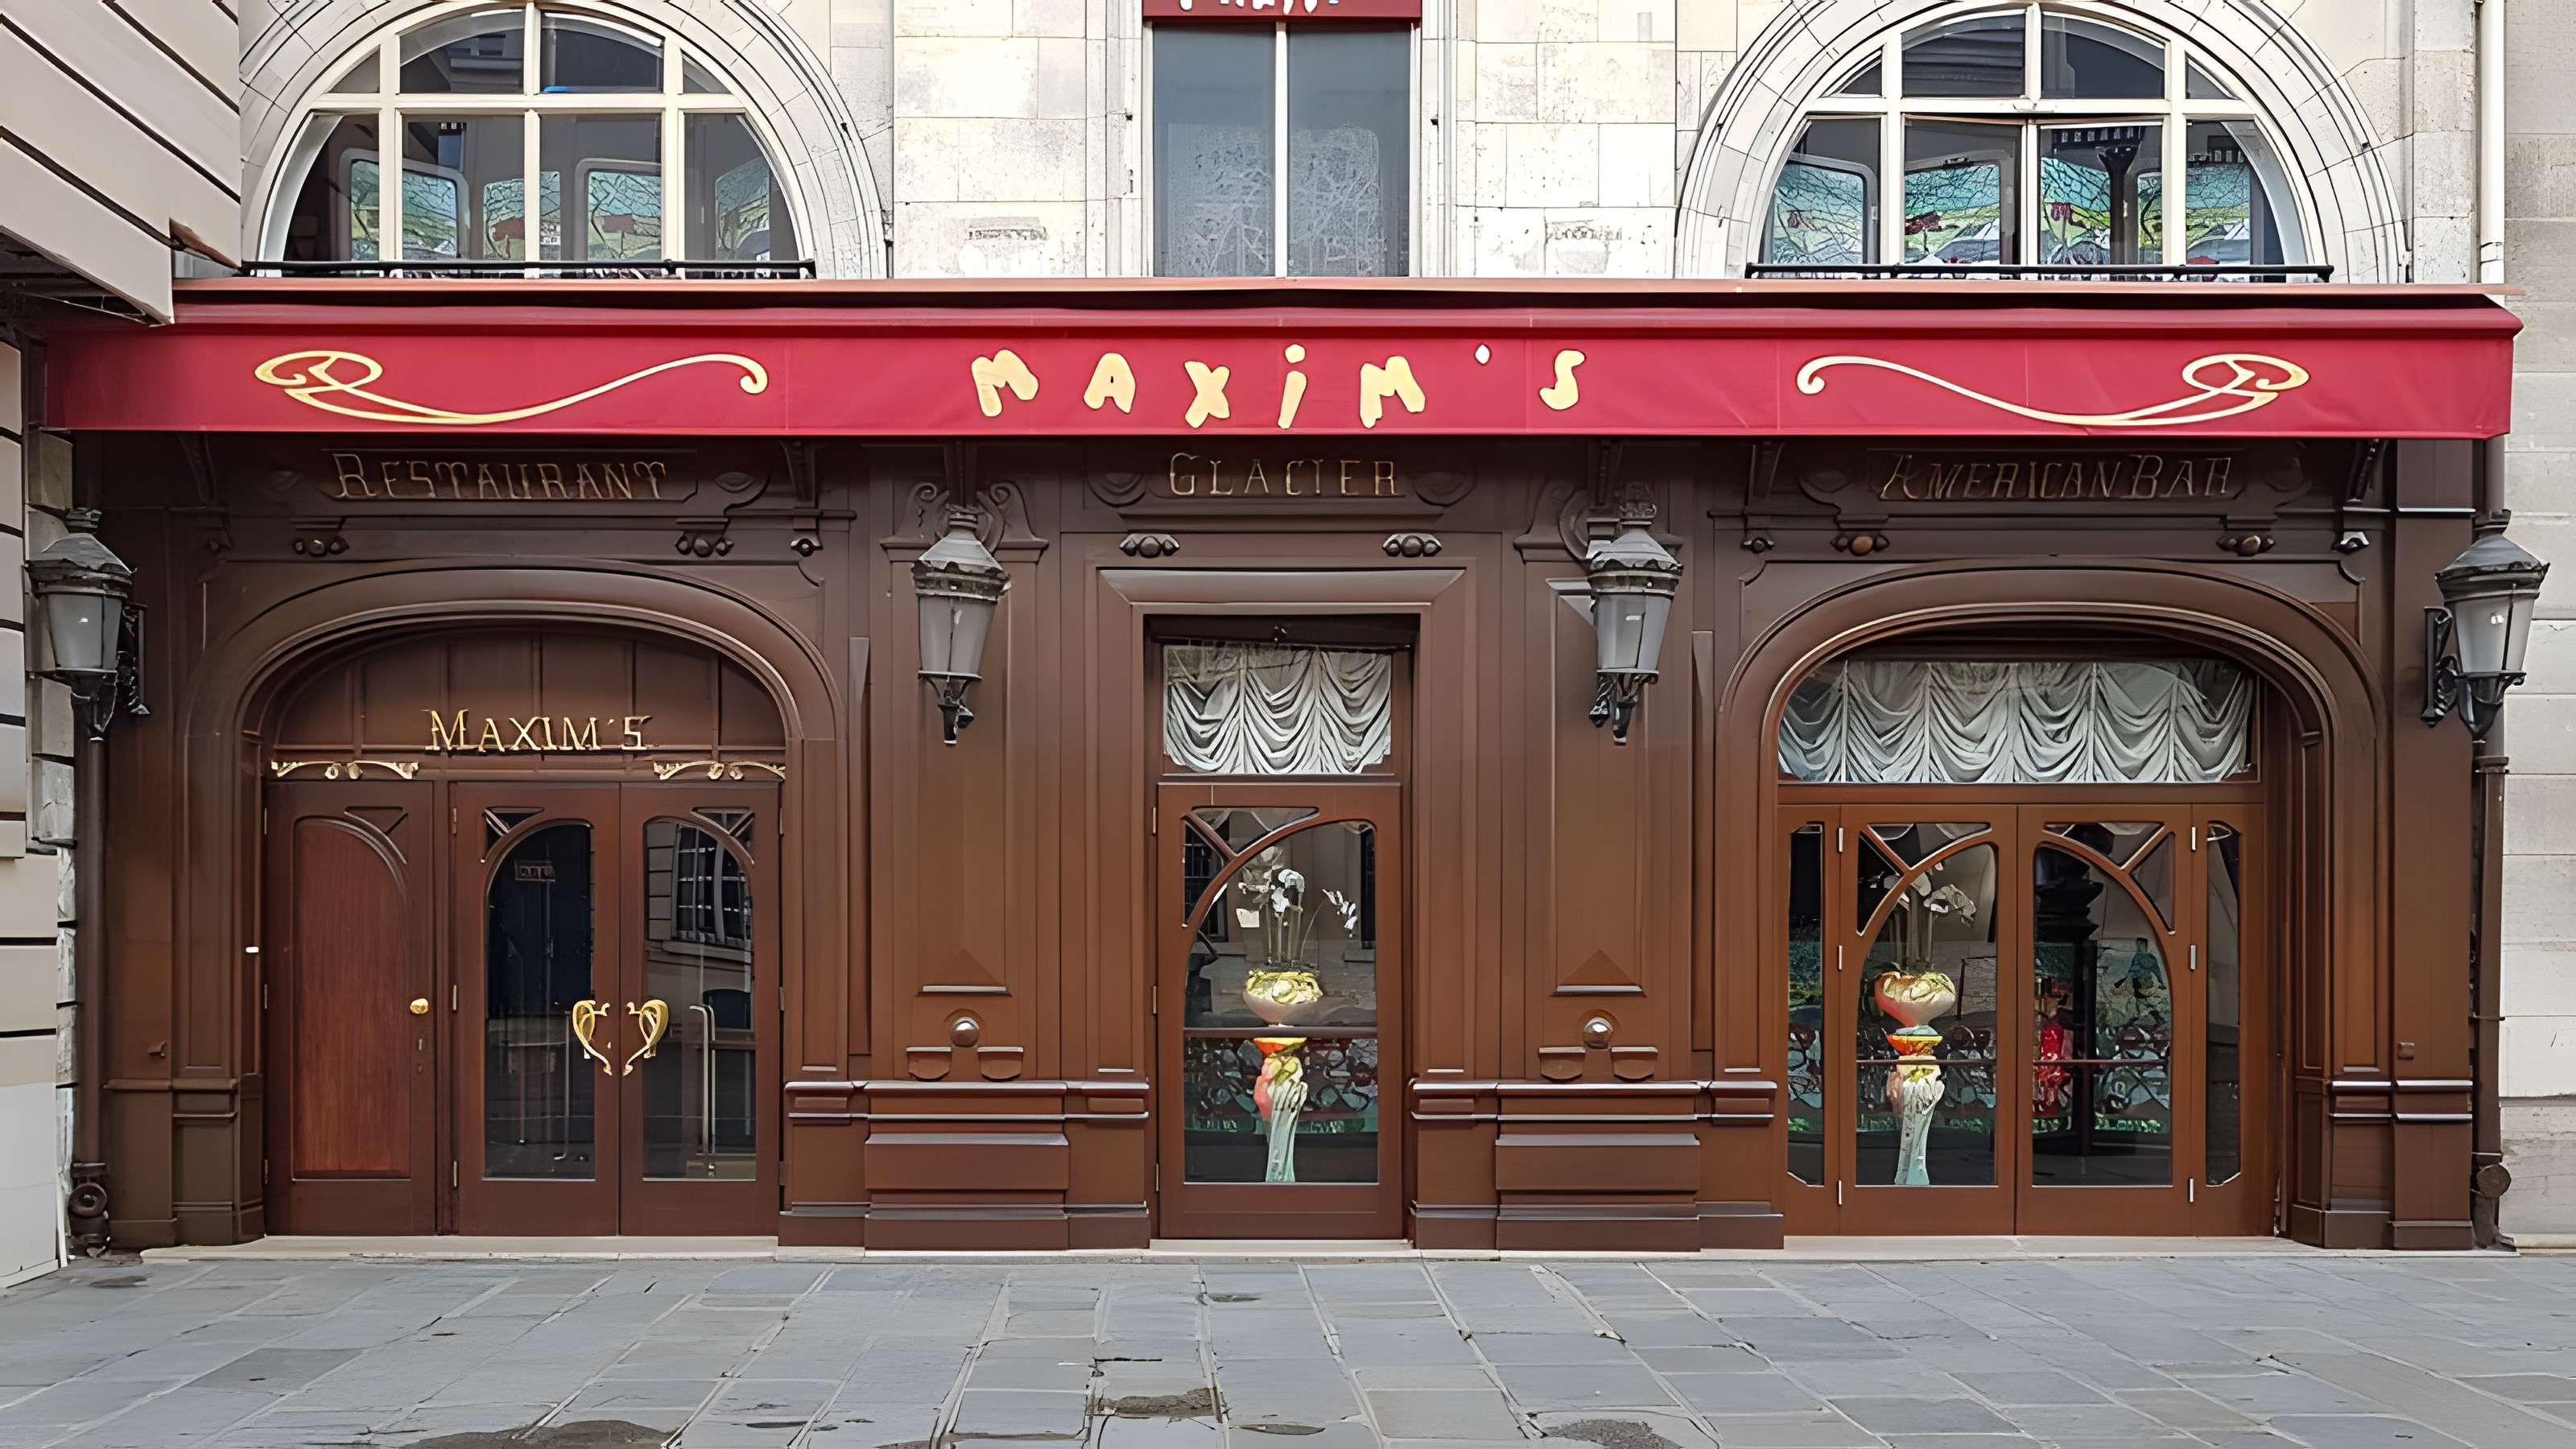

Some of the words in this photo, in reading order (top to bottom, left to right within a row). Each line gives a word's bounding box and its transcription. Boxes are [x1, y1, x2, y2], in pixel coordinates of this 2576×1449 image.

[332, 453, 666, 499] RESTAURANT
[1170, 452, 1402, 495] GLACIER
[1880, 454, 2121, 499] AMERICAN
[2122, 454, 2231, 497] BAR
[420, 708, 652, 752] MAXIM'S
